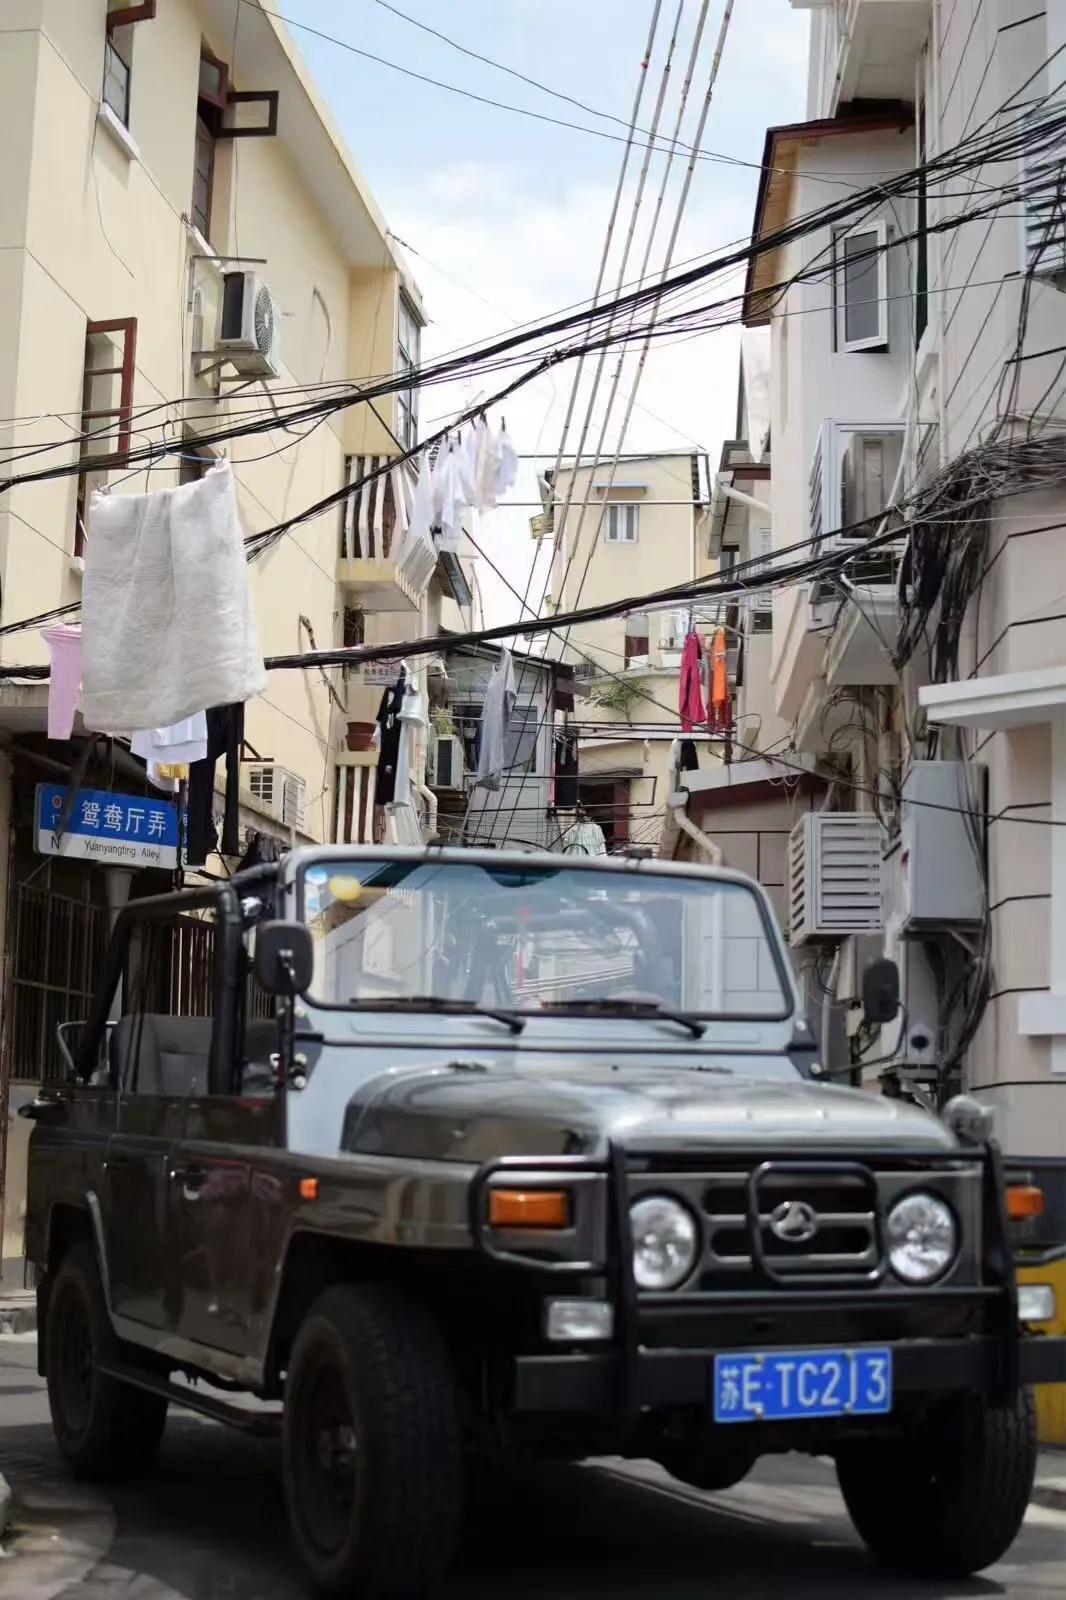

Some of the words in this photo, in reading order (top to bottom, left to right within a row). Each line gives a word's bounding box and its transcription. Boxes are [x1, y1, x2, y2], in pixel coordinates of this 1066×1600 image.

[81, 800, 167, 838] 鸳鸯厅弄
[84, 840, 136, 857] Yuanyangting
[141, 847, 160, 861] Alley
